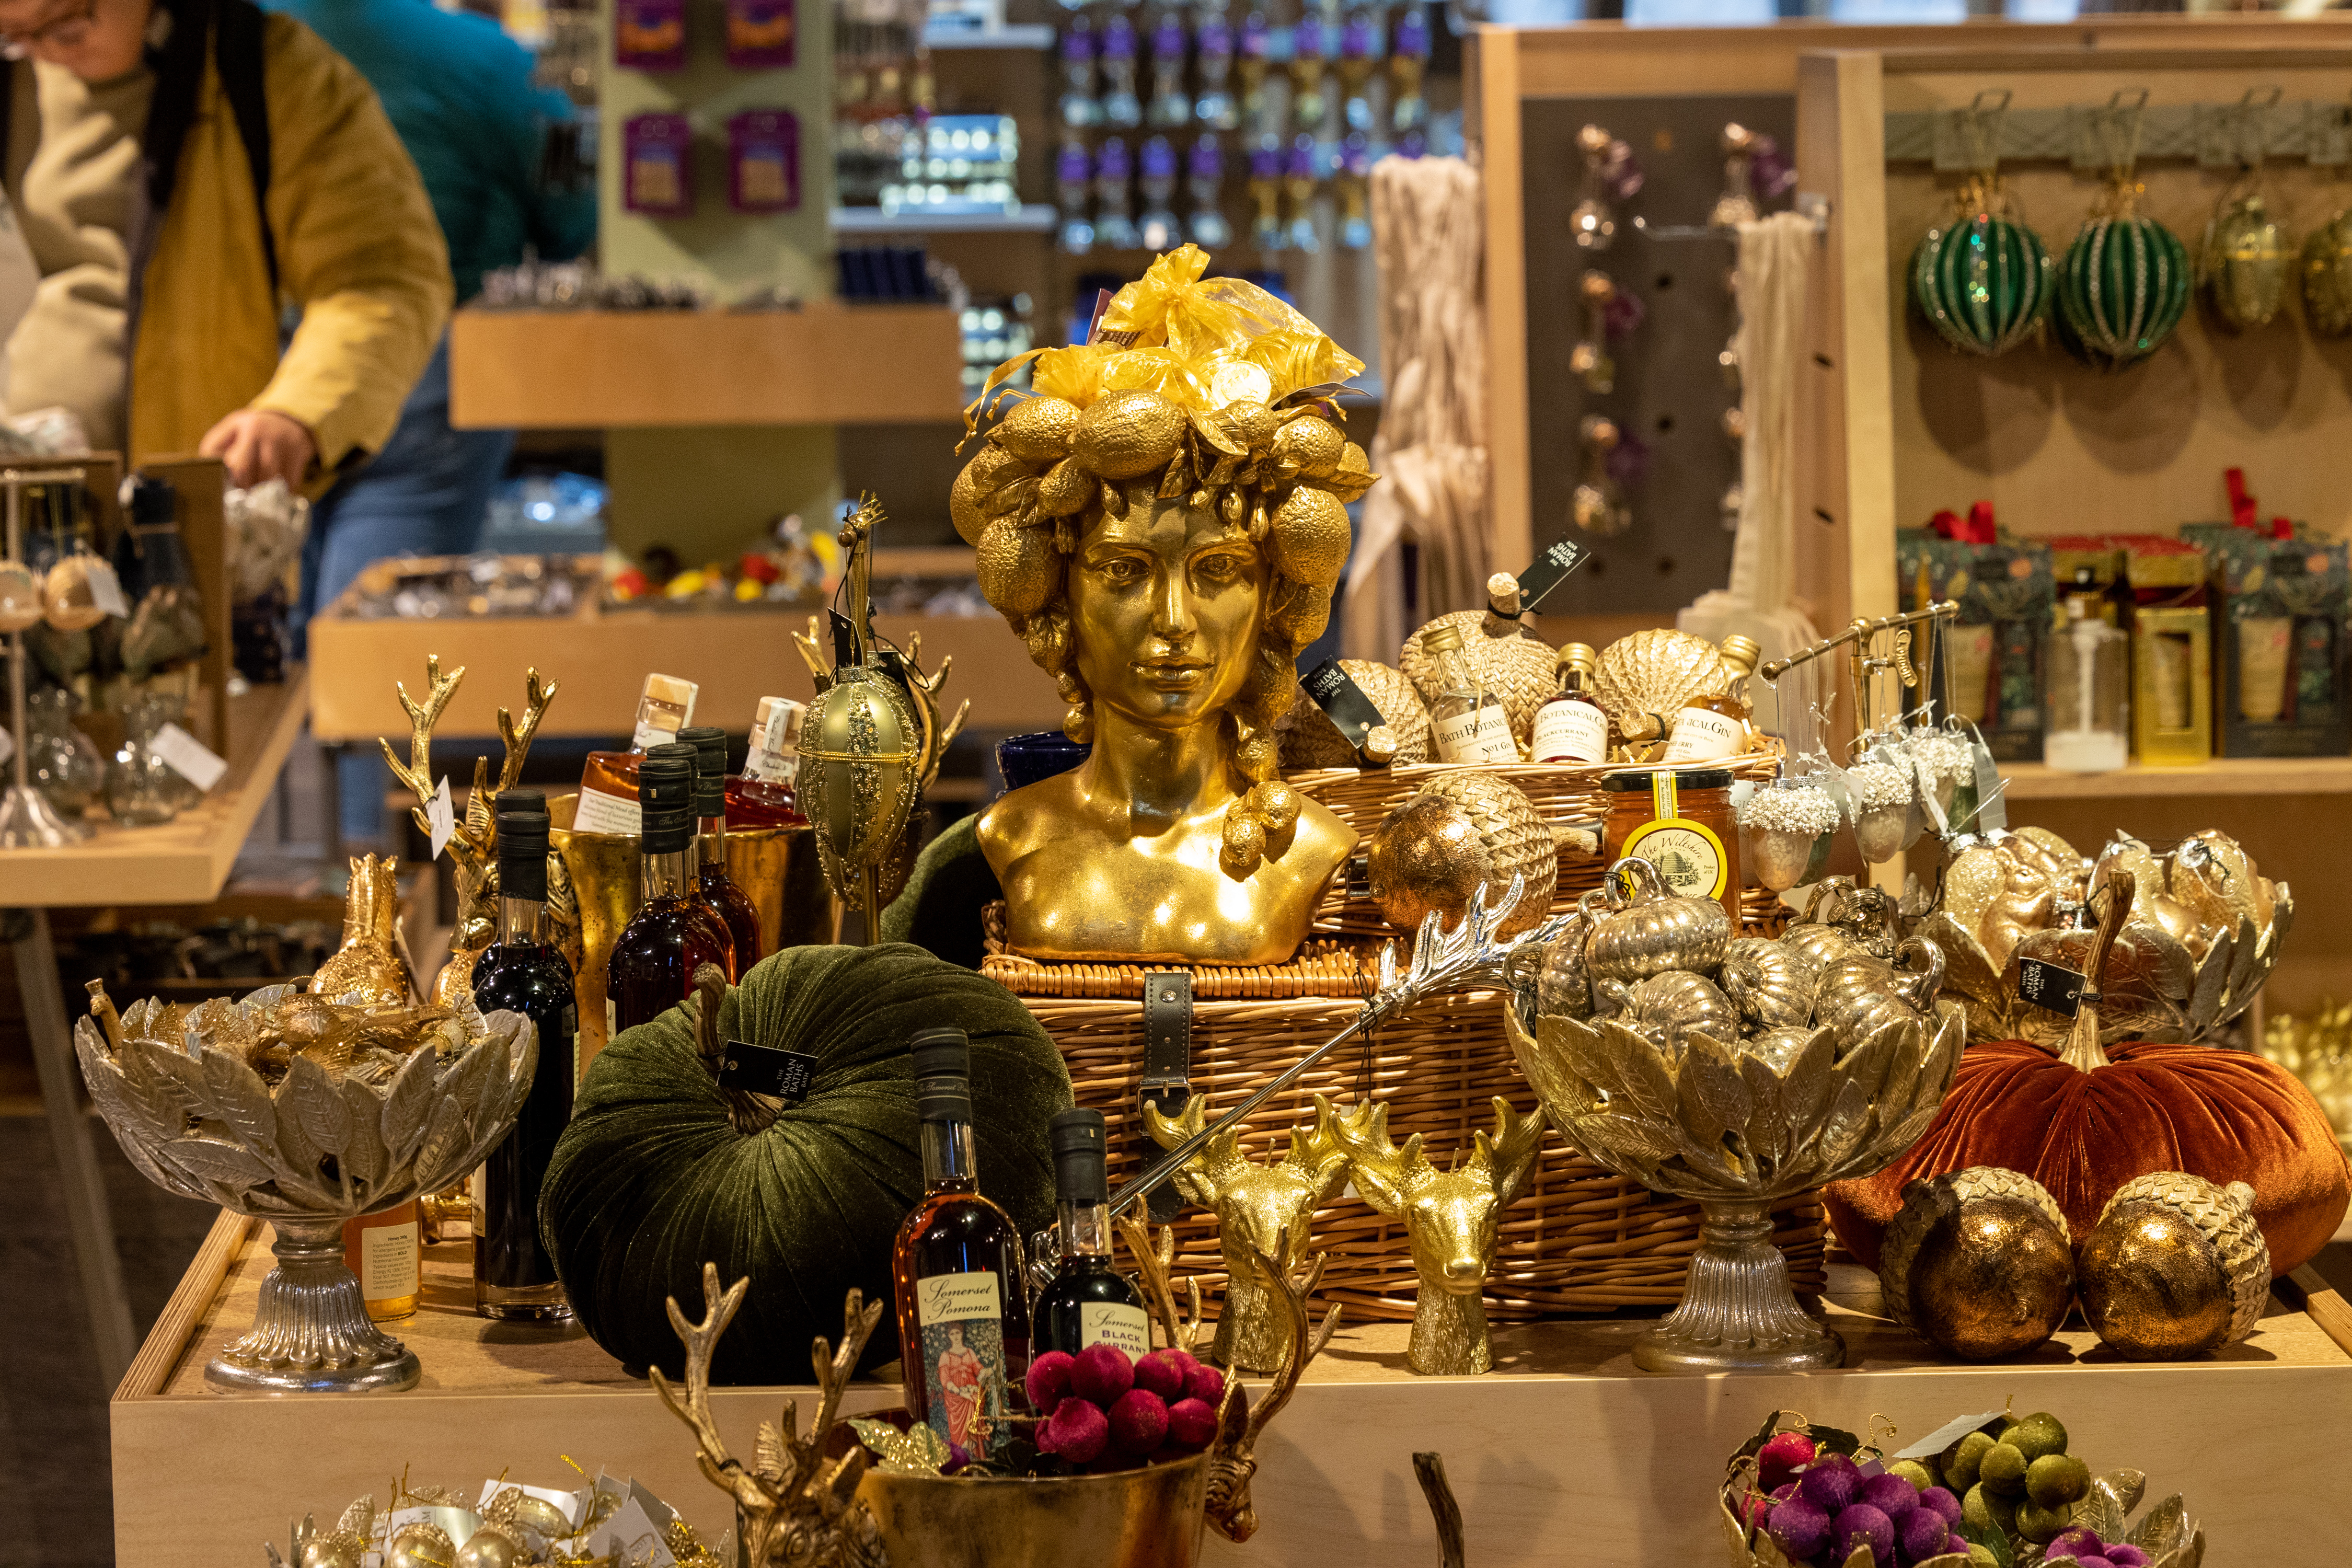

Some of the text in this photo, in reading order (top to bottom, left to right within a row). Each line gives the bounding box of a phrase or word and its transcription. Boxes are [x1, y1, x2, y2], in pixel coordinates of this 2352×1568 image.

[1547, 547, 1572, 567] ROMAN
[1555, 543, 1577, 560] BATHS
[1313, 668, 1338, 690] BATHS
[1316, 673, 1345, 699] ROMAN
[1331, 688, 1342, 697] THE
[1642, 833, 1706, 860] The Wiltshire
[2026, 966, 2035, 994] BATHS
[2032, 965, 2042, 999] ROMAN
[780, 1059, 797, 1094] ROMAN
[789, 1064, 804, 1092] BATHS
[925, 1279, 992, 1303] Somerset
[928, 1298, 990, 1321] Pomona
[1089, 1308, 1145, 1332] Somerset
[1102, 1330, 1140, 1343] BLACK
